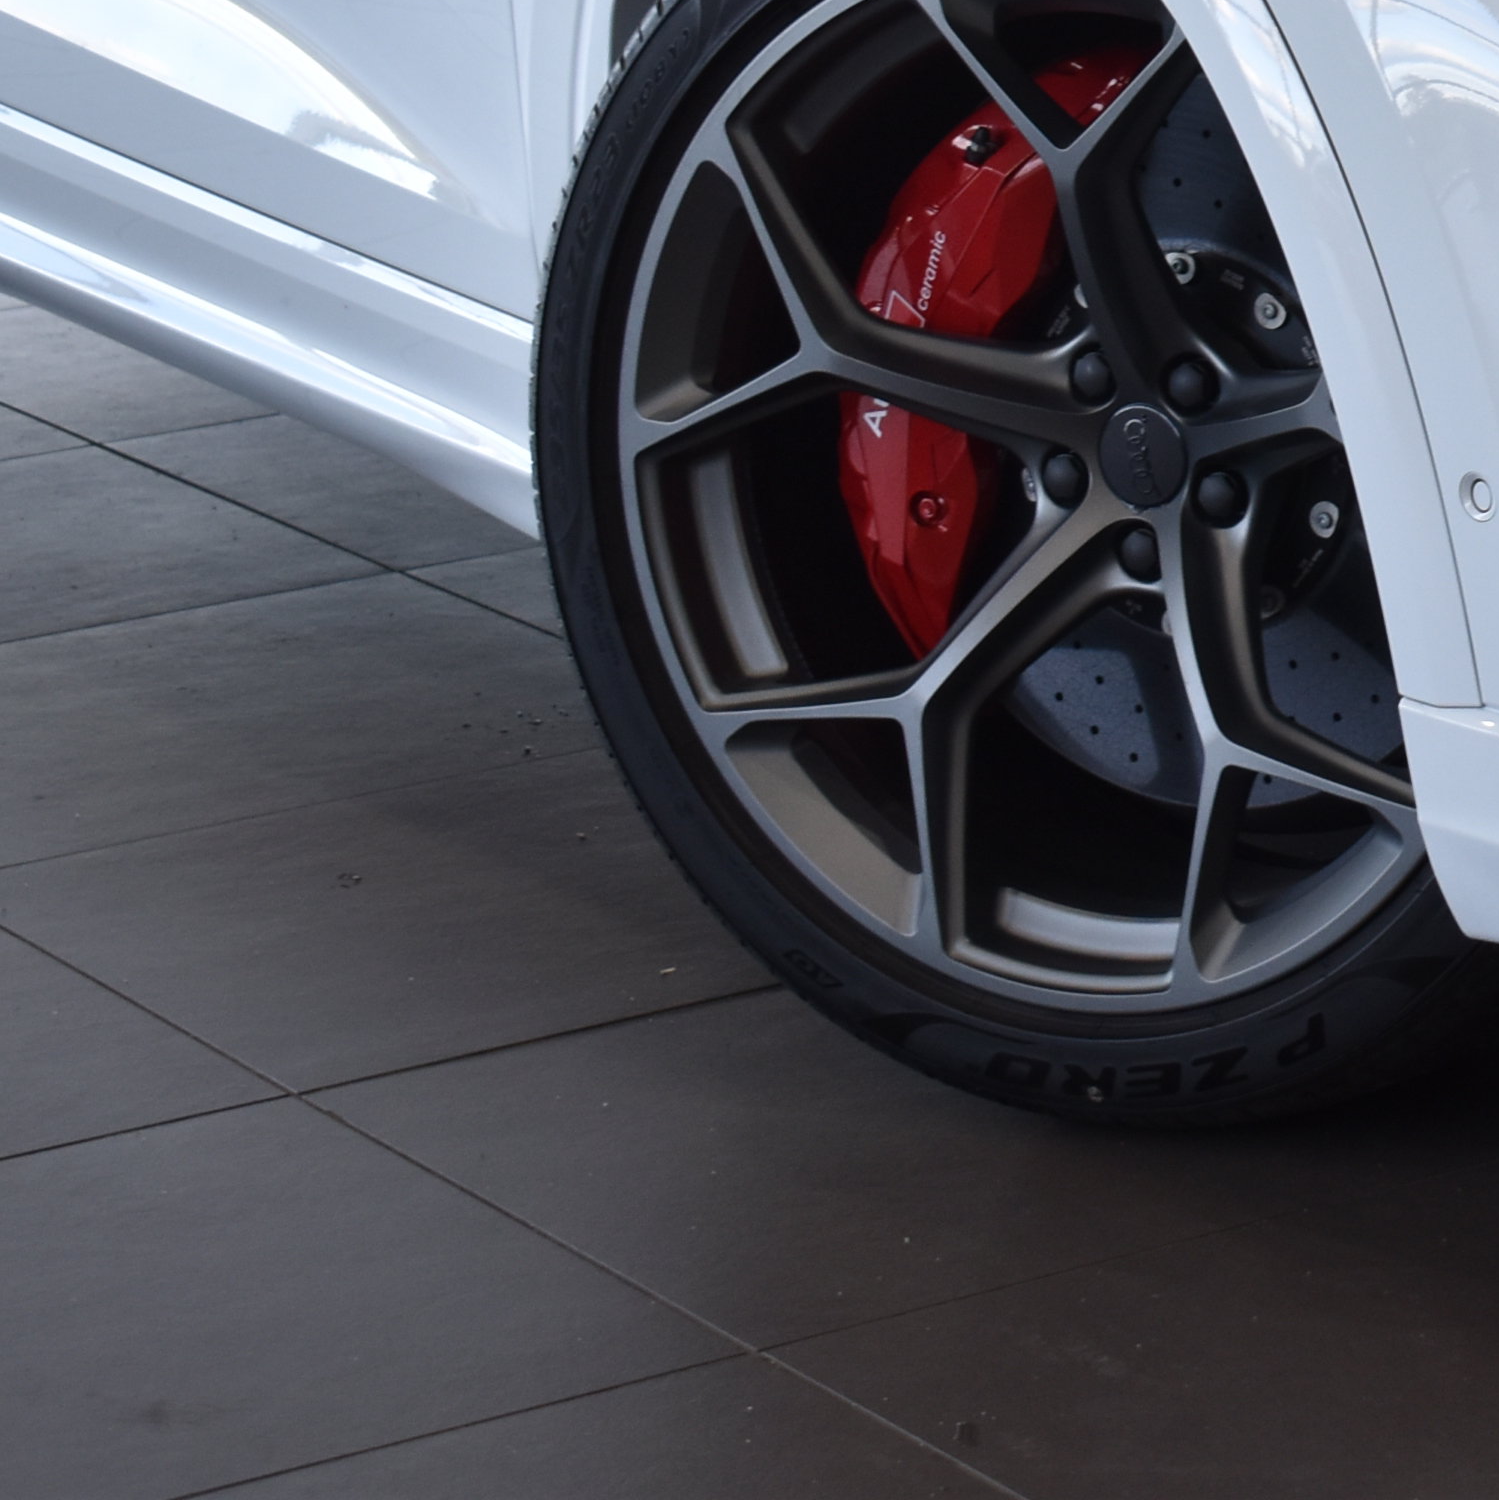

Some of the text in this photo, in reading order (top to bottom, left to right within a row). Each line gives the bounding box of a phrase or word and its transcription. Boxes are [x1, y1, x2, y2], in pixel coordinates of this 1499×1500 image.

[917, 230, 947, 312] ceramic
[984, 1011, 1326, 1100] P ZERO
